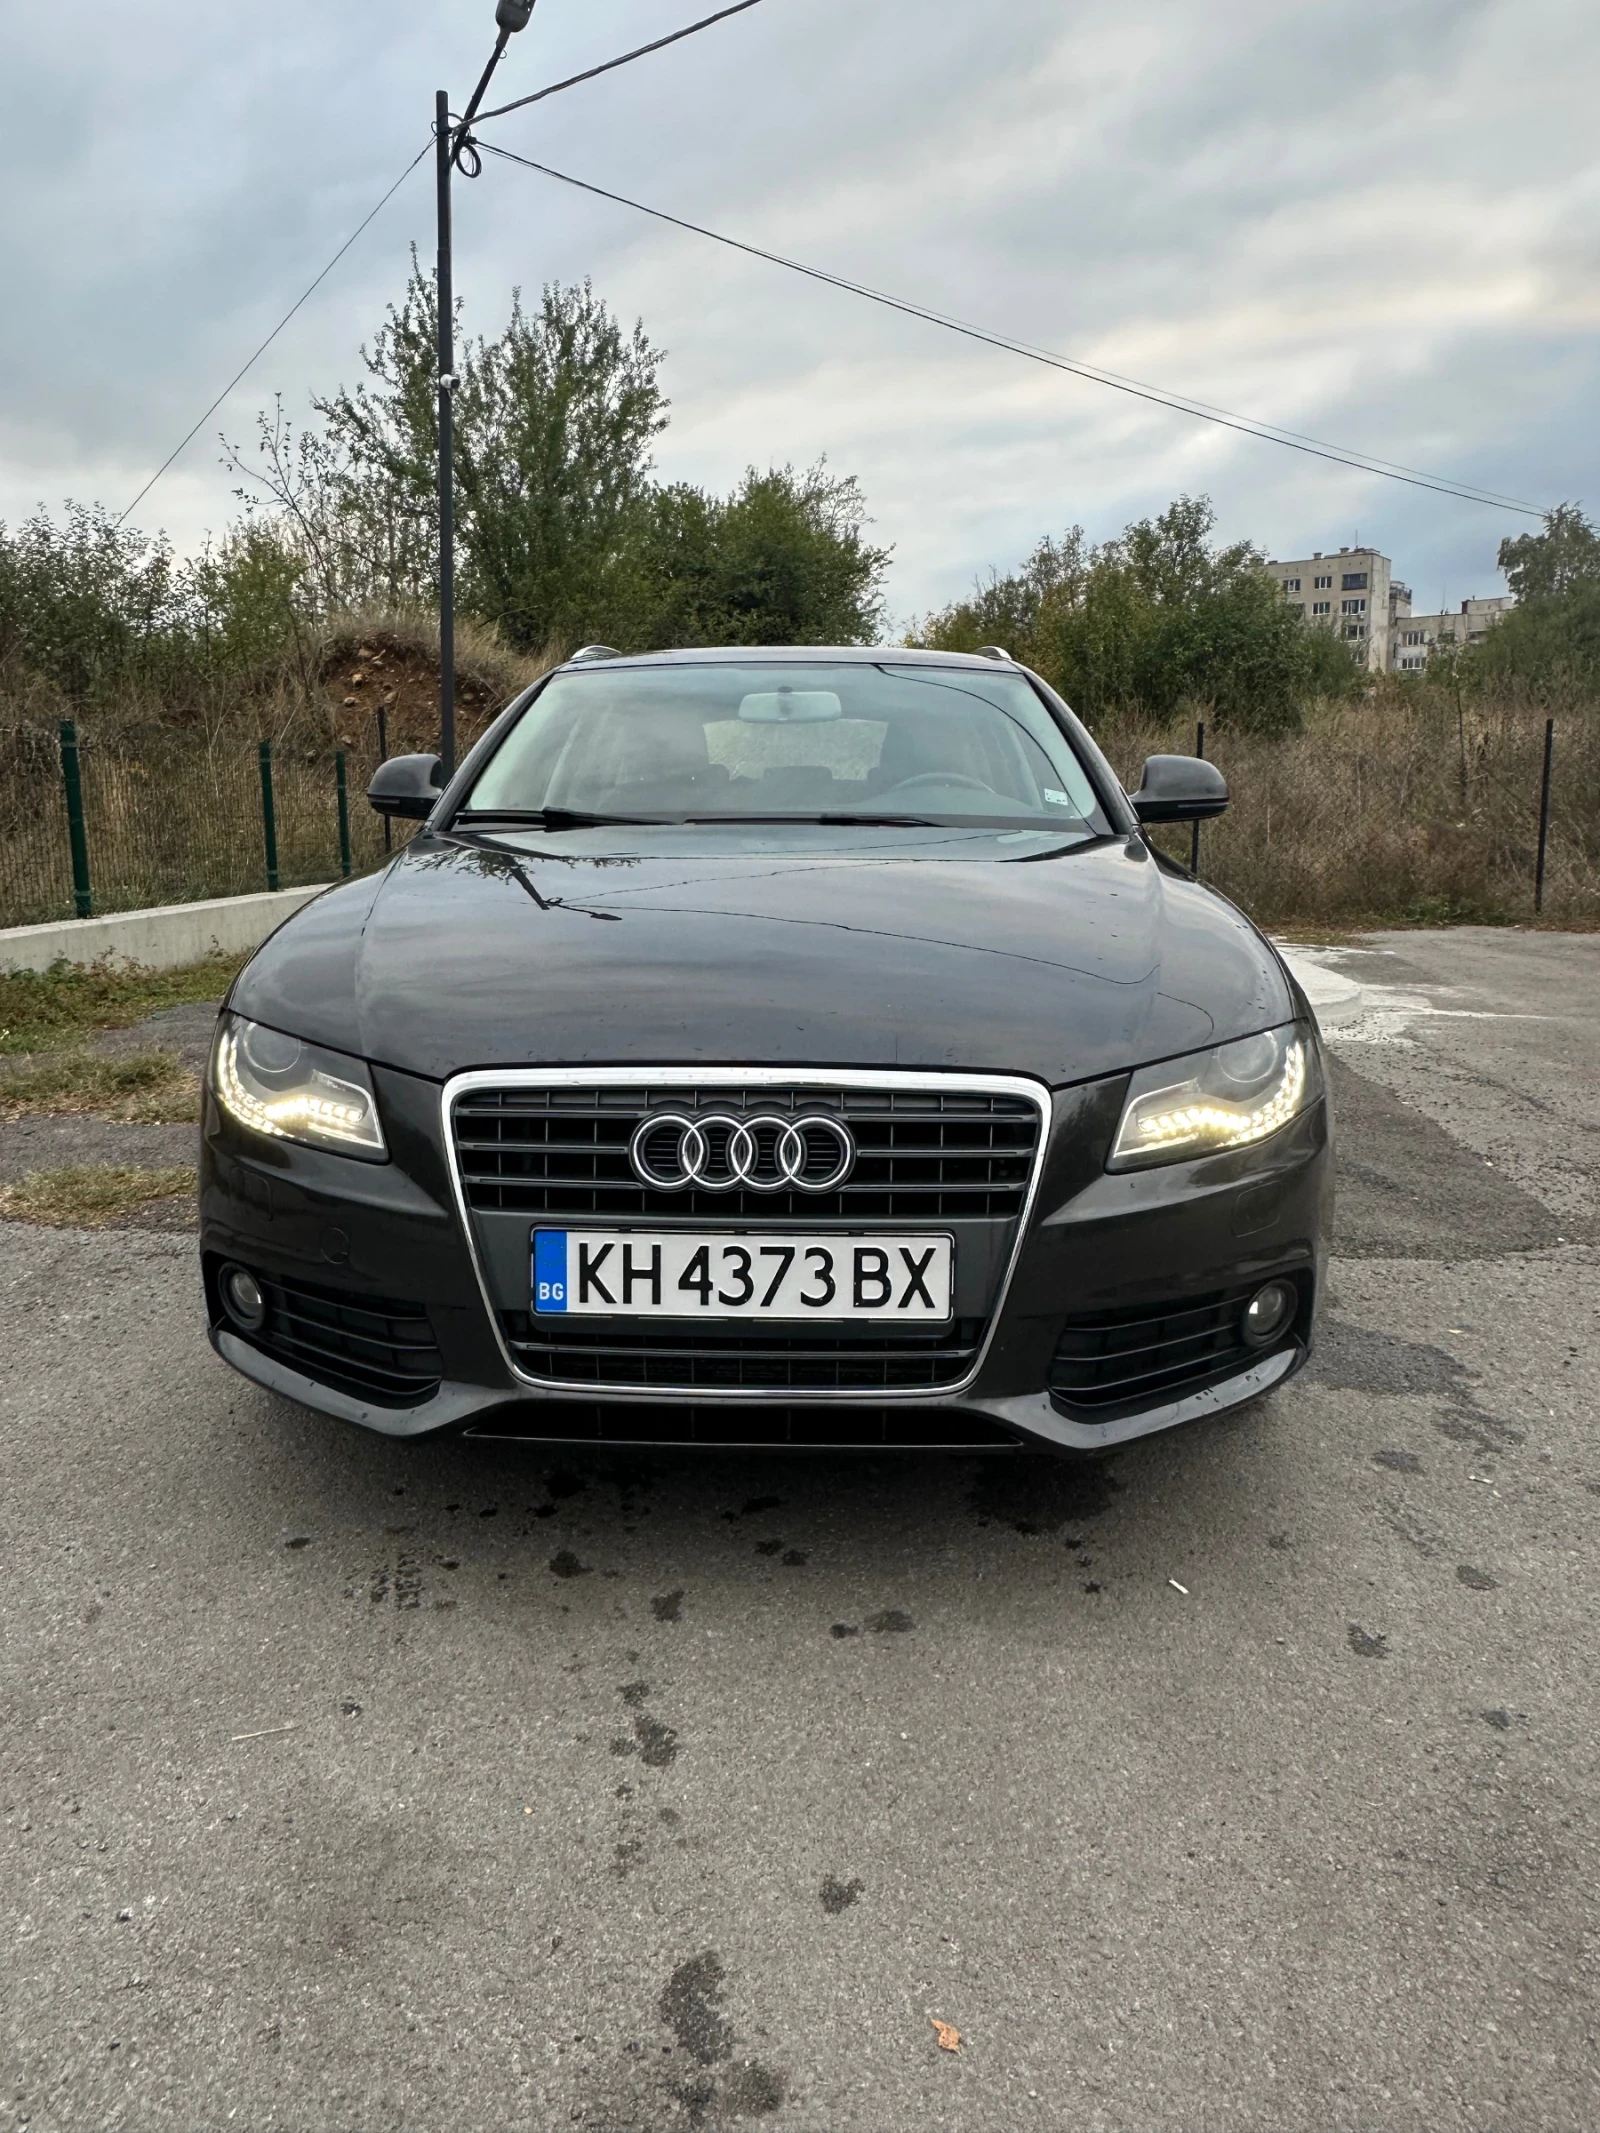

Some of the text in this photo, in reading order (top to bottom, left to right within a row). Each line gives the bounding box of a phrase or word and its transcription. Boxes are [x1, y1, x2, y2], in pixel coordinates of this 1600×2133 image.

[538, 1283, 564, 1301] BG
[578, 1243, 937, 1309] KH 4373 BX
